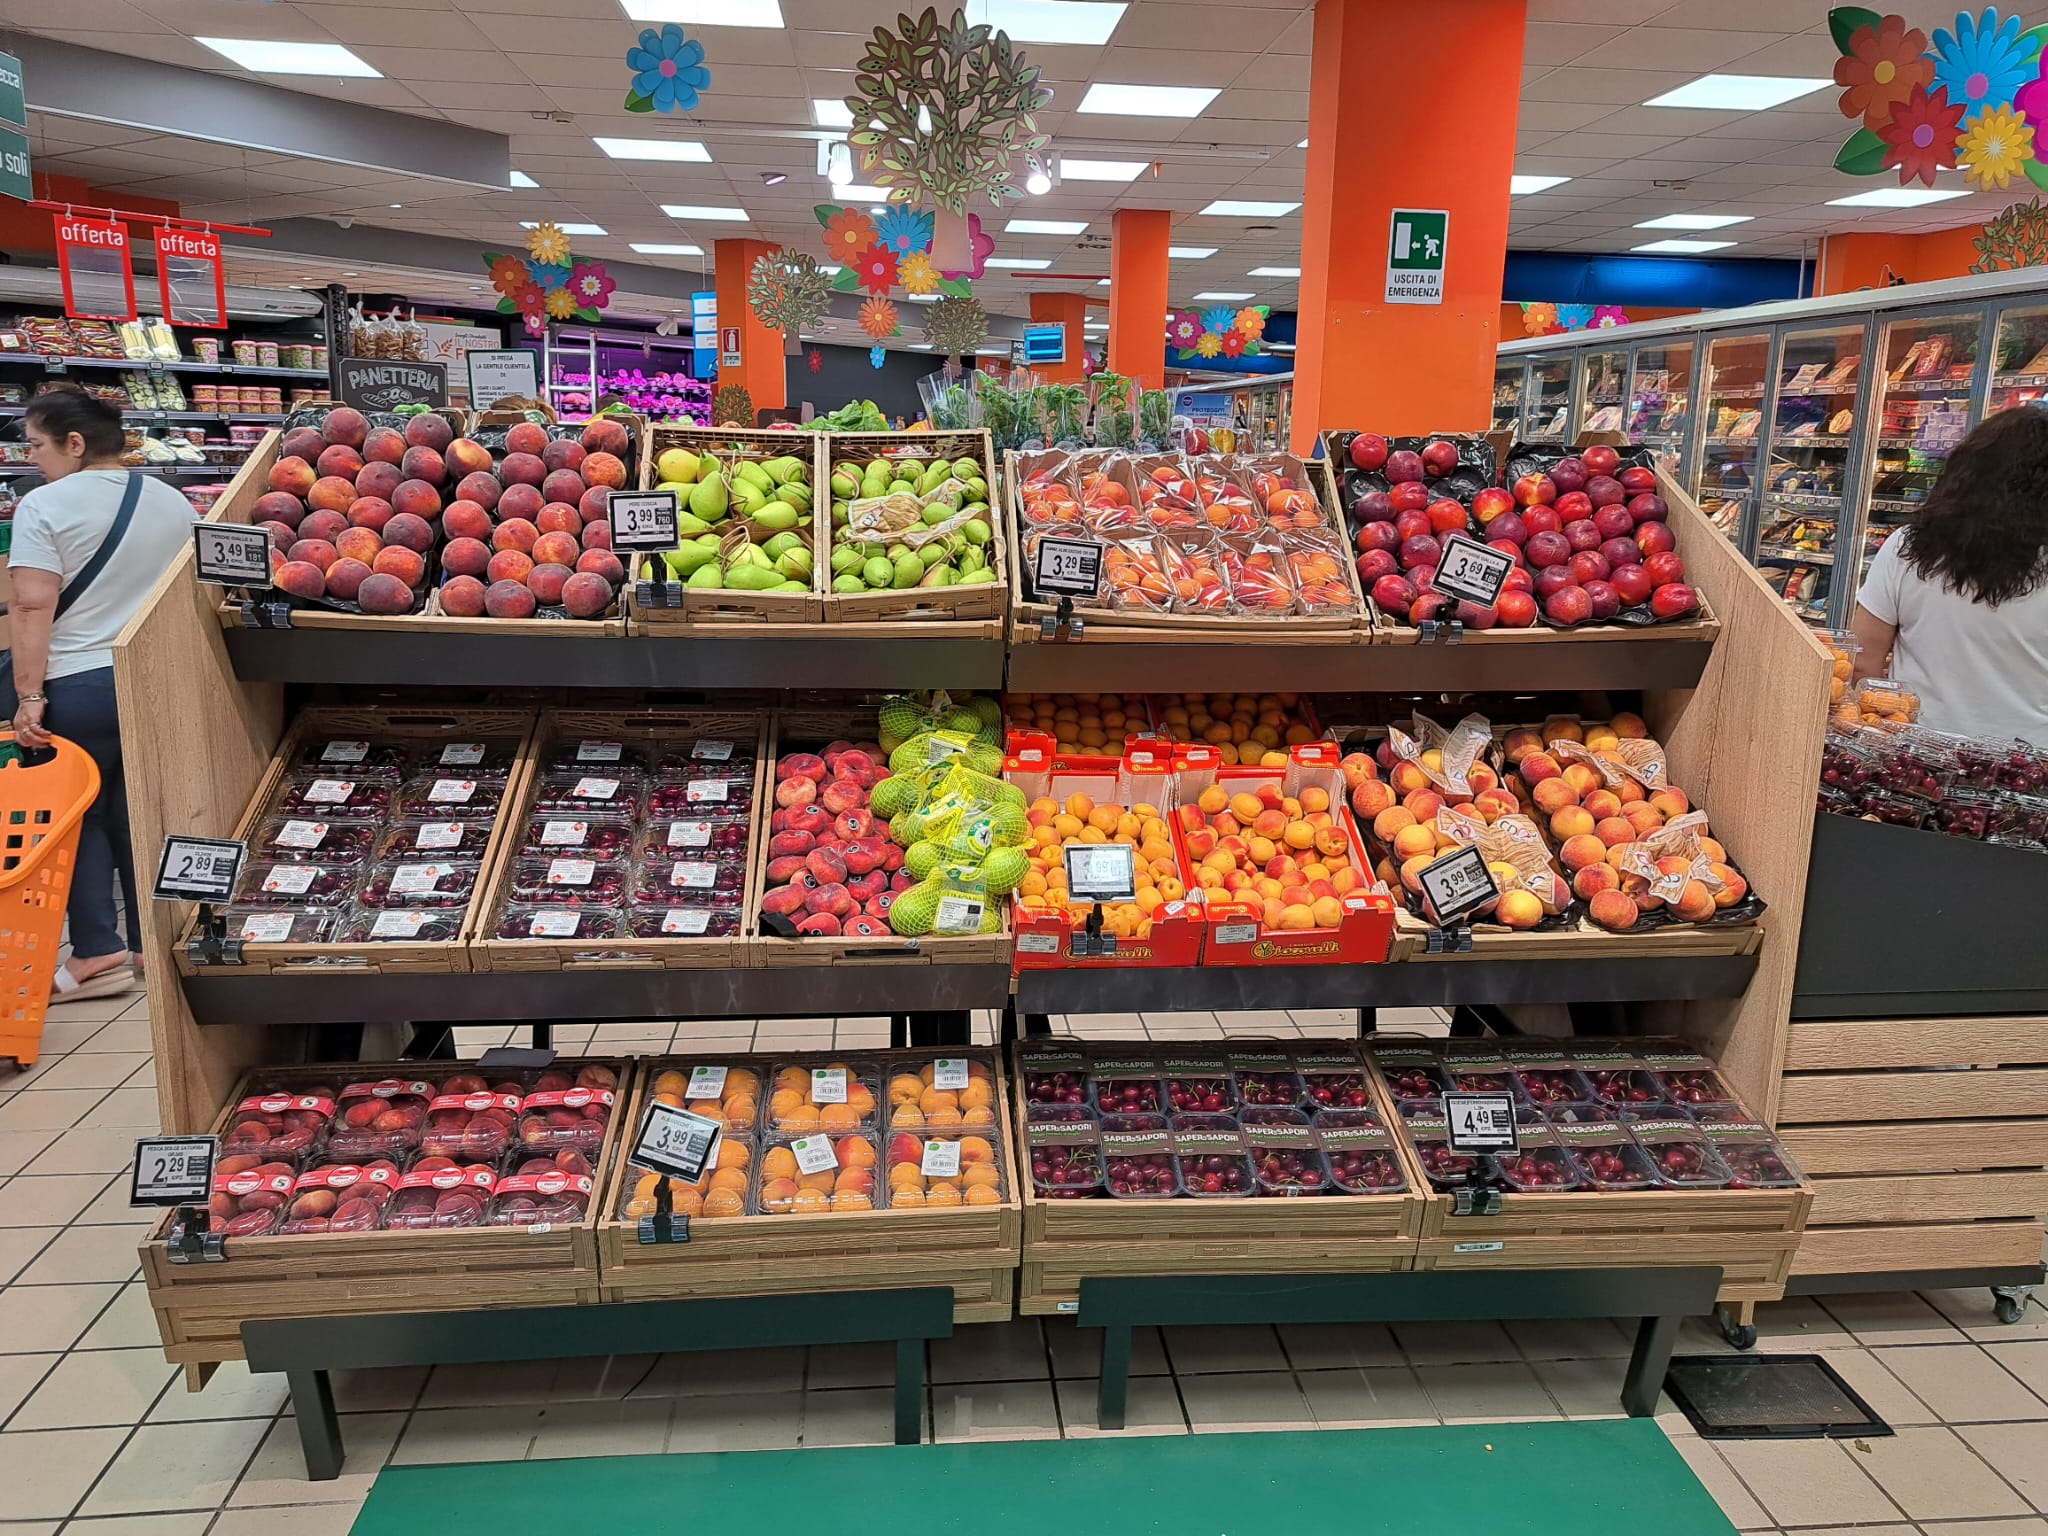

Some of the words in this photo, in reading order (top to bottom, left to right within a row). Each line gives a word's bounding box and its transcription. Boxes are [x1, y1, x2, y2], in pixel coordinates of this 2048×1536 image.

[6, 152, 29, 178] soli
[62, 223, 123, 247] offerta
[161, 234, 217, 257] offerta
[1394, 274, 1425, 285] USCITA
[1428, 274, 1437, 285] DI
[1388, 286, 1440, 297] EMERGENZA
[465, 339, 500, 349] NOSTRO
[348, 367, 440, 393] PANETTERIA
[1052, 1053, 1082, 1061] SAPORI
[1124, 1061, 1154, 1069] SAPORI
[1193, 1060, 1224, 1068] SAPORI
[1028, 1124, 1056, 1132] SAPER
[1059, 1123, 1092, 1132] SAPORI
[1406, 1120, 1433, 1128] SAPER
[1557, 1125, 1584, 1133] SAPER
[1587, 1124, 1618, 1133] SAPORI
[1630, 1123, 1659, 1132] SAPER
[1661, 1122, 1695, 1130] SAPORI
[1246, 1126, 1273, 1135] SAPER
[1276, 1127, 1309, 1136] SAPORI
[1321, 1130, 1349, 1139] SAPER
[1352, 1129, 1385, 1138] SAPORI
[1103, 1134, 1132, 1143] SAPER
[1135, 1132, 1169, 1142] SAPORI
[1175, 1134, 1202, 1142] SAPER
[1205, 1133, 1238, 1142] SAPORI
